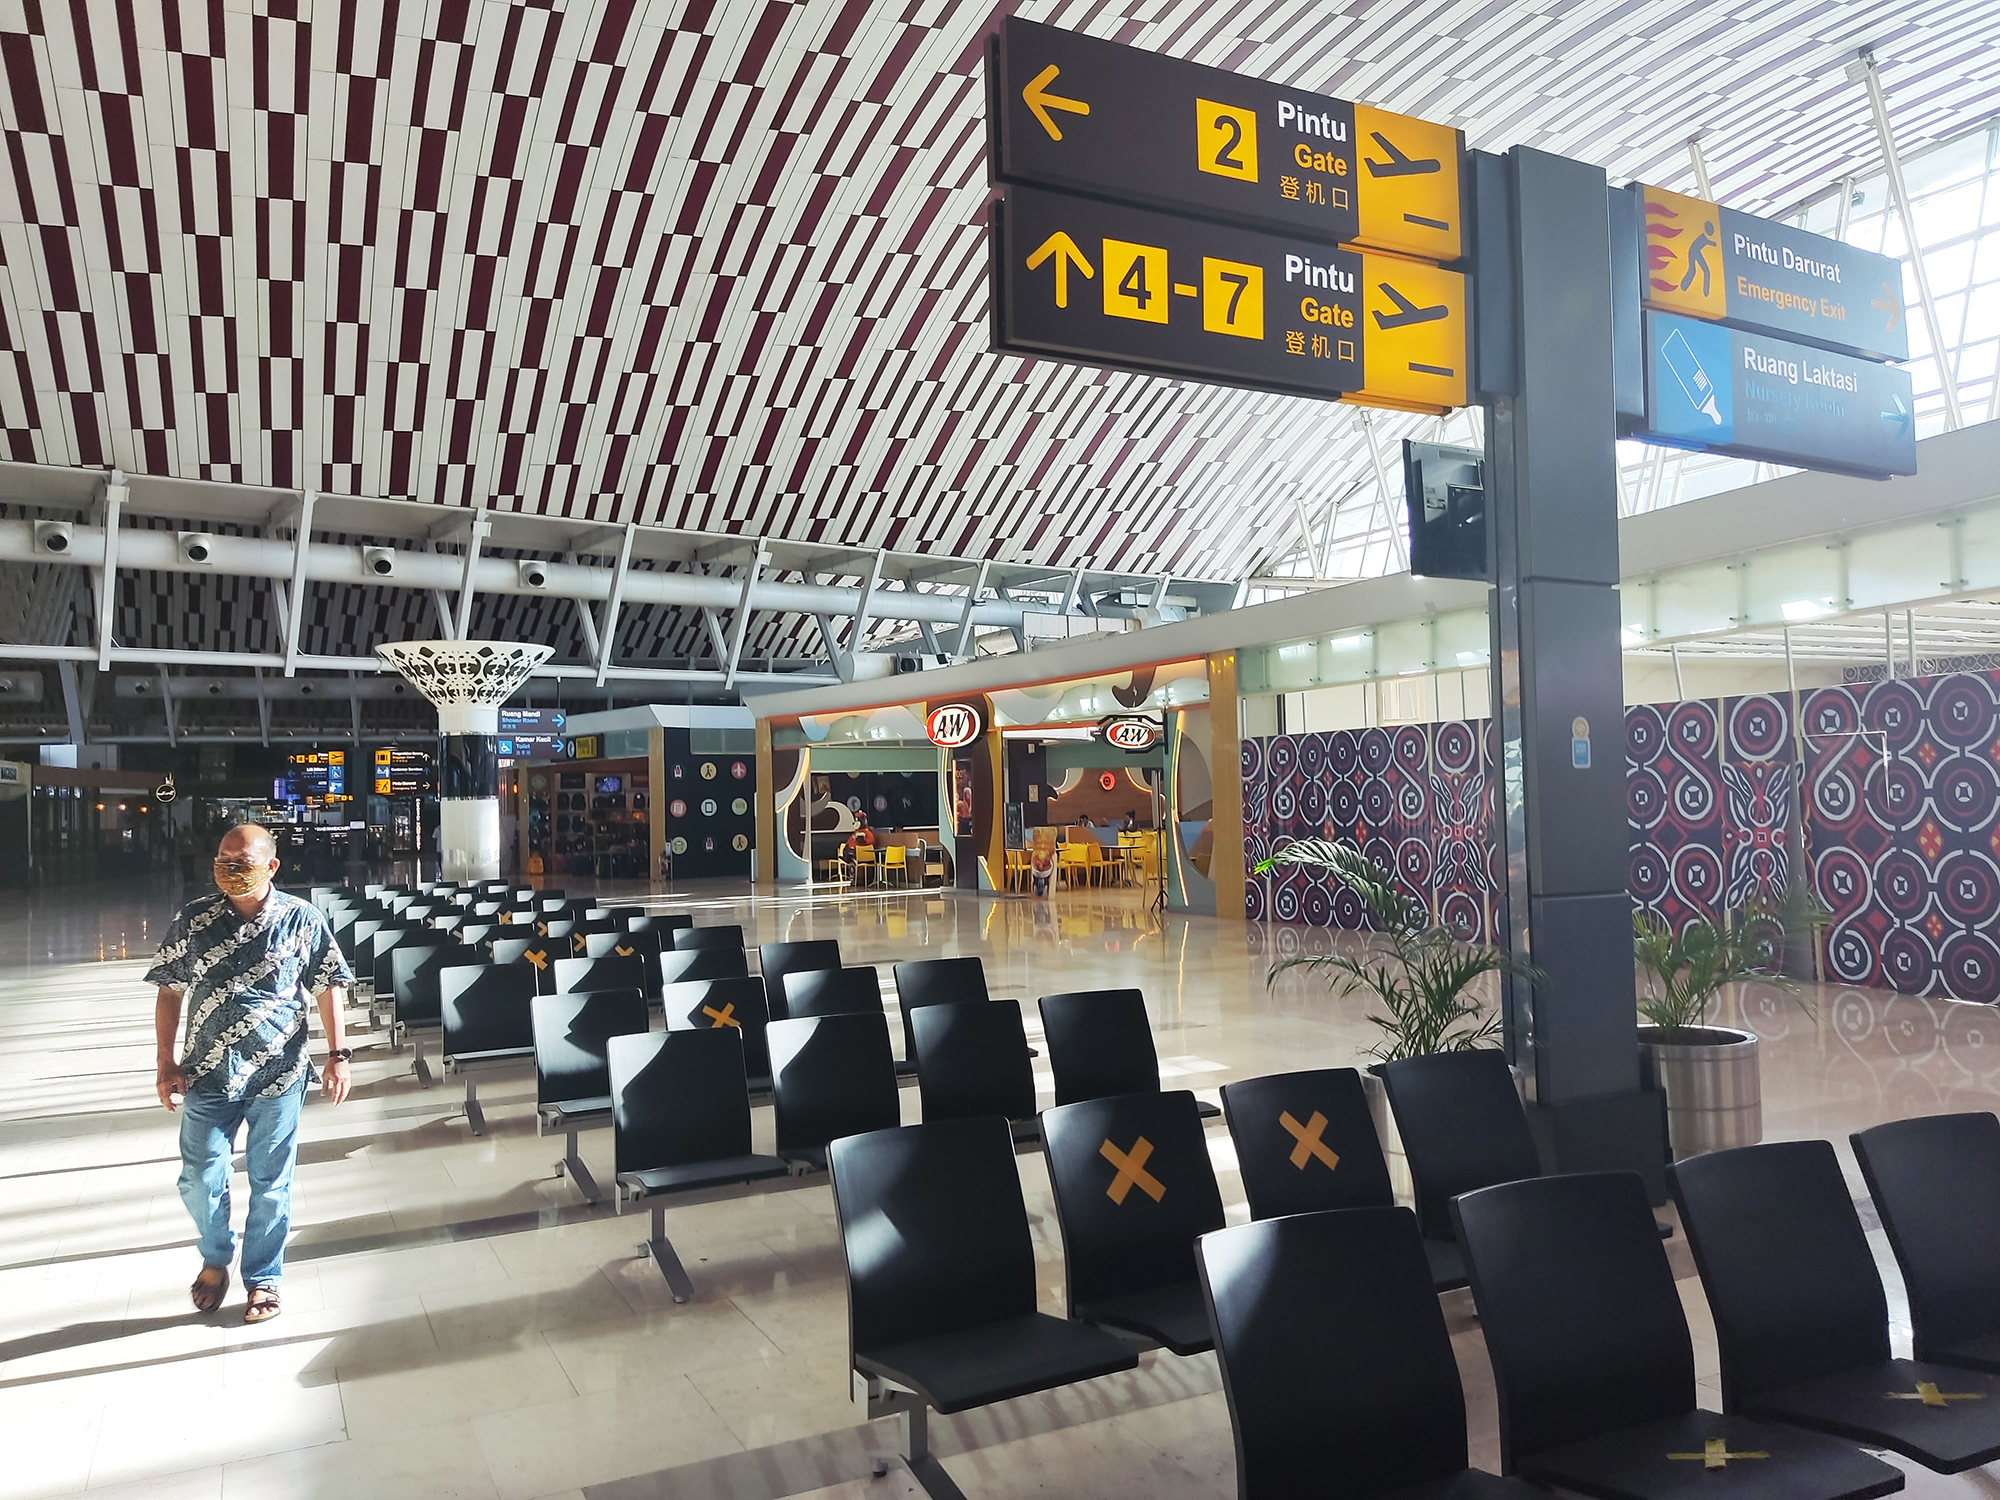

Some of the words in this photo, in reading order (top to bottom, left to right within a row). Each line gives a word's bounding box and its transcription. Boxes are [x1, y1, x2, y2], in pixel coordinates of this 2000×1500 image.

[1278, 100, 1347, 142] Pintu
[1213, 115, 1244, 170] 2
[1294, 143, 1347, 176] Gate
[1280, 175, 1348, 210] 登机口
[1285, 254, 1354, 294] Pintu
[1734, 232, 1778, 266] Pintu
[1782, 247, 1841, 284] Darurat
[1118, 255, 1152, 311] 4
[1220, 271, 1249, 325] 7
[1737, 276, 1816, 318] Emergency
[1820, 297, 1846, 321] Exit
[1300, 297, 1354, 328] Gate
[1285, 330, 1354, 362] 登机口
[1743, 346, 1798, 385] Ruang
[1802, 360, 1858, 393] Laktasi
[1745, 379, 1801, 413] Nursery
[501, 710, 522, 719] Ruang
